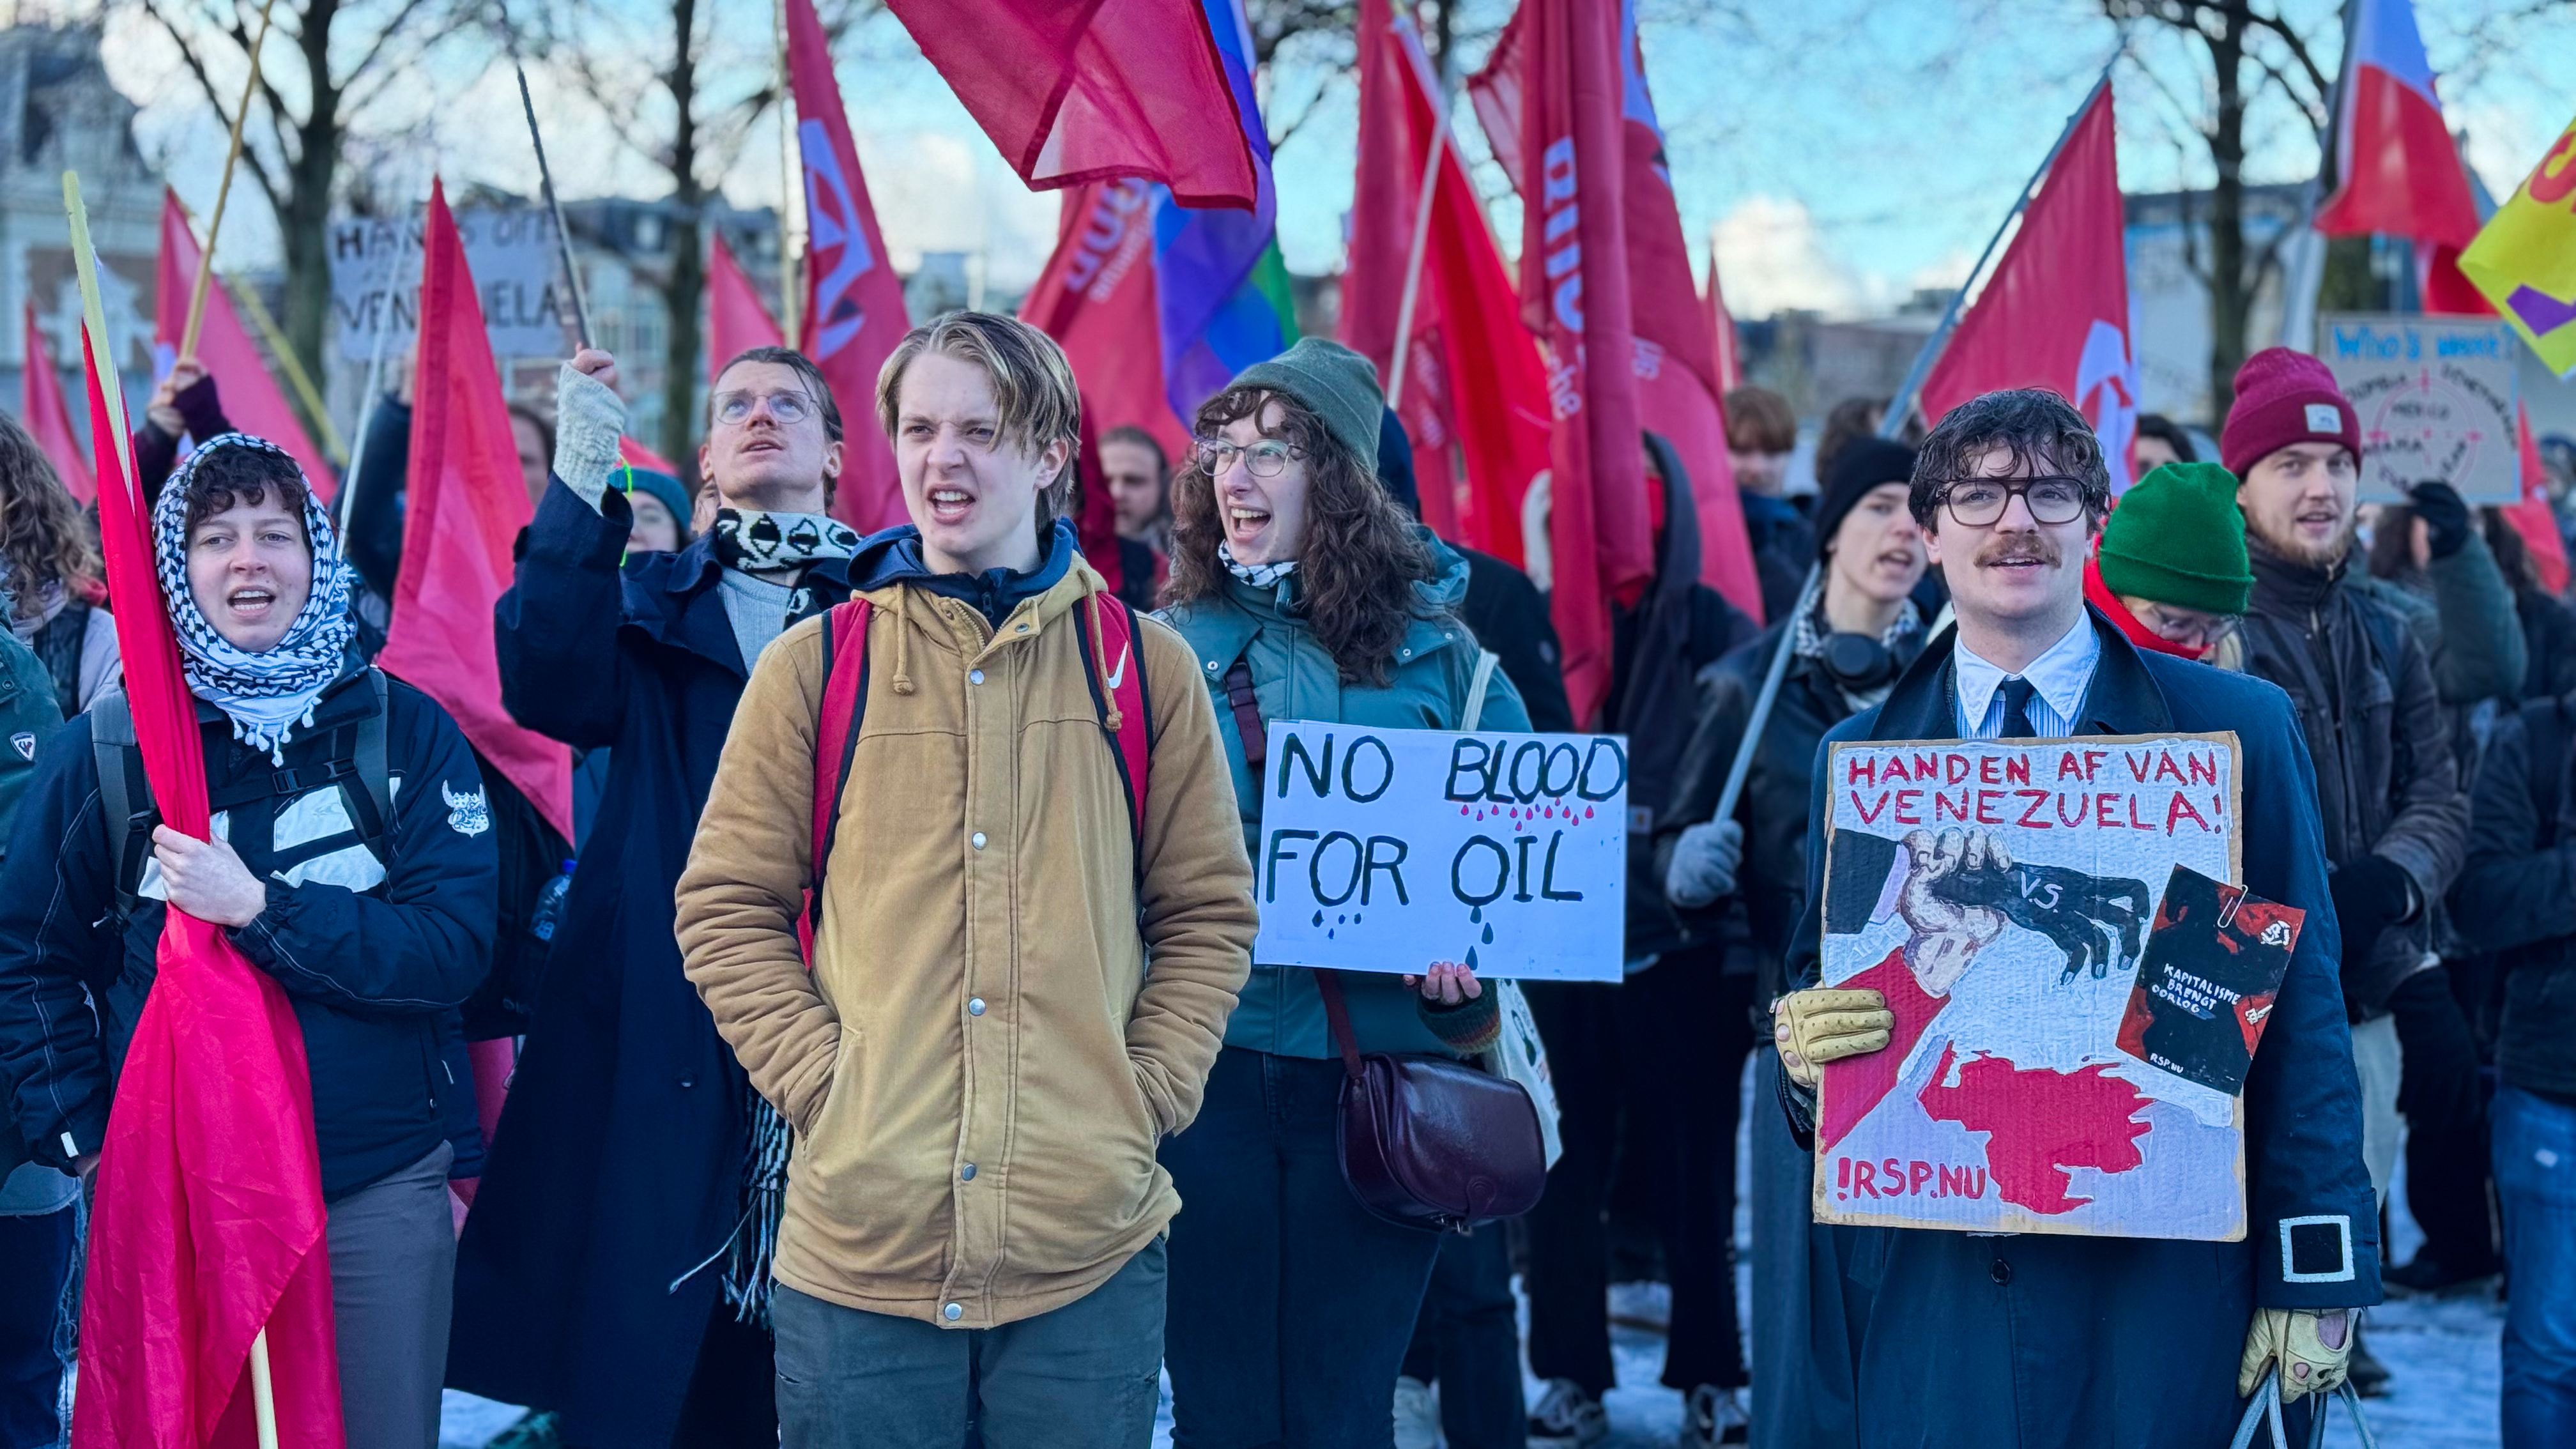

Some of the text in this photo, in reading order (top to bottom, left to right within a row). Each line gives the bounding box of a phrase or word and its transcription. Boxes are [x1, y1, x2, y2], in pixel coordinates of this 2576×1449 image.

[336, 220, 478, 259] HANS
[1278, 732, 1628, 805] NO BLOOD
[1847, 748, 2218, 788] HANDEN AF VAN
[1850, 787, 2222, 837] VENEZUELA!
[1266, 829, 1584, 907] FOR OIL
[2151, 983, 2202, 1013] OORLOG
[2163, 962, 2242, 1006] KAPITALISME
[2166, 978, 2218, 1011] BRENGT
[2149, 1052, 2184, 1074] RSP.NU
[1837, 1156, 1987, 1200] !RSP.NU
